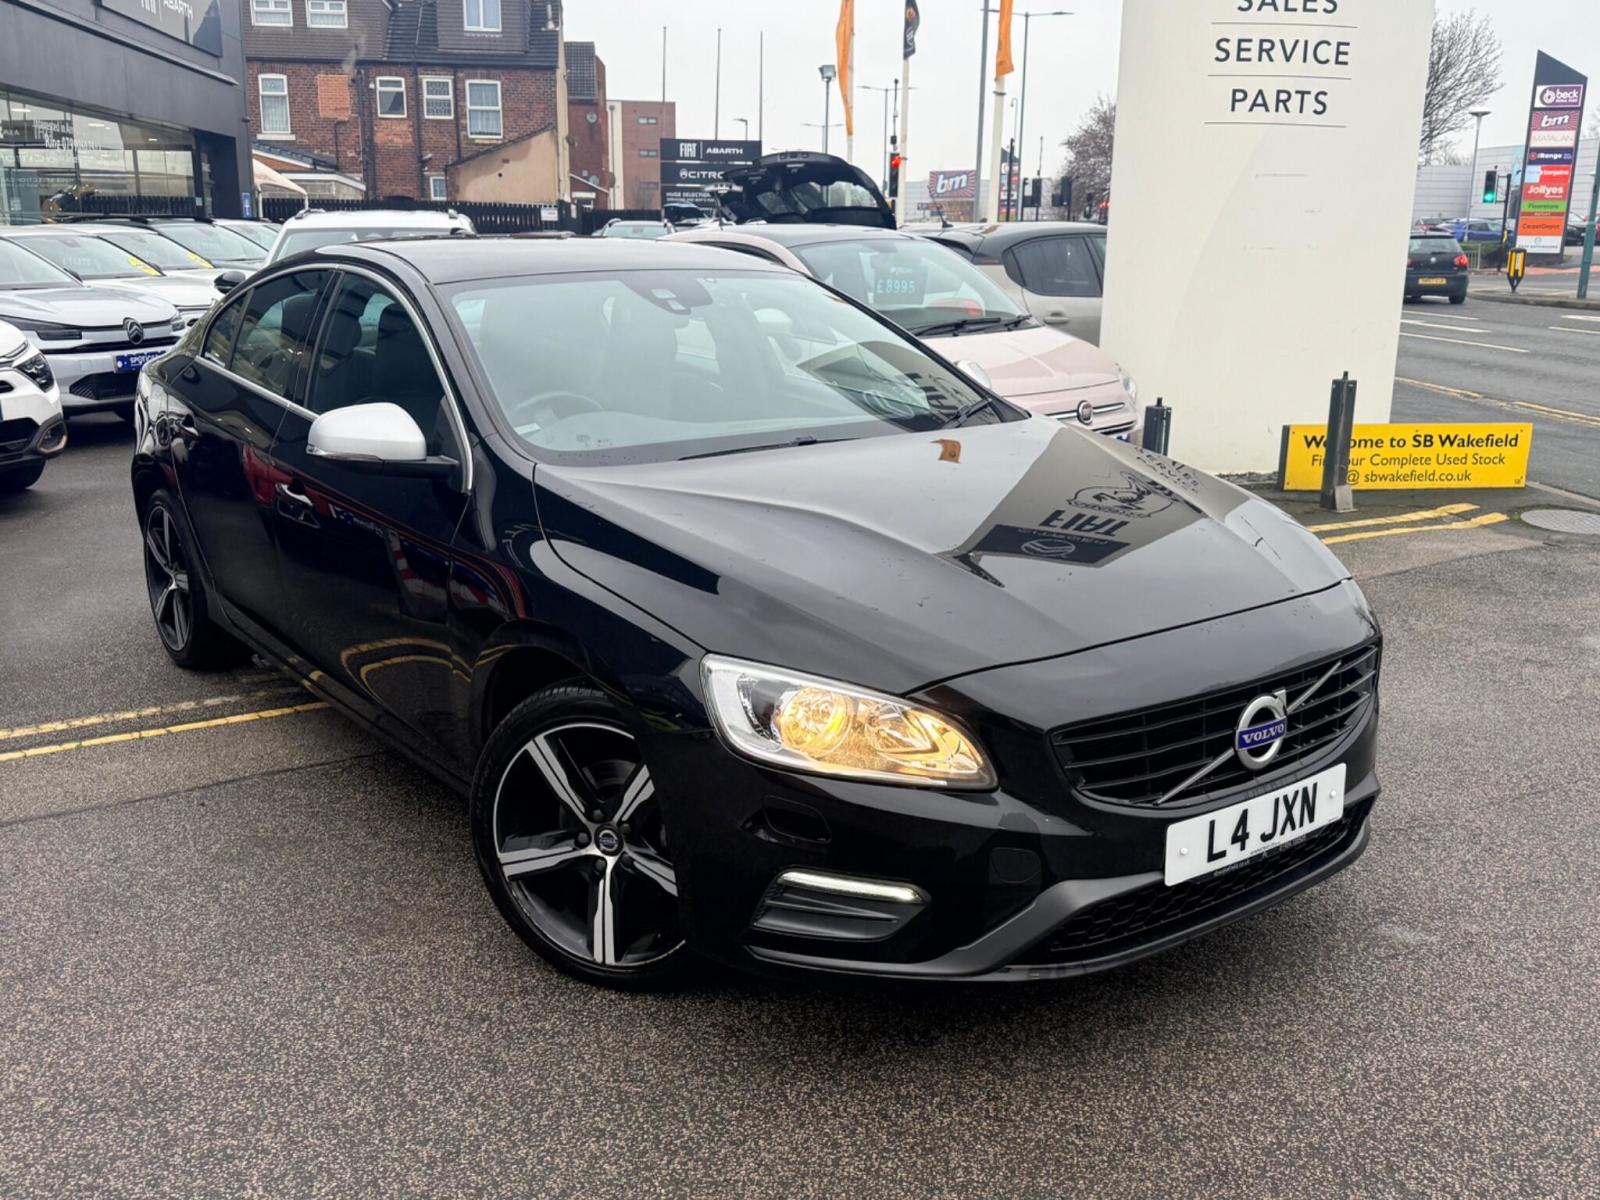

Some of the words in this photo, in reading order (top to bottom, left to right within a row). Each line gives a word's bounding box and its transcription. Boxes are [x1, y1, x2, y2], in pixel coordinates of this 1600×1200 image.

[1214, 37, 1350, 66] SERVICE
[1230, 88, 1328, 115] PARTS
[680, 142, 697, 158] FIAT
[876, 279, 916, 294] £8995
[1304, 434, 1384, 448] Wome
[1389, 437, 1406, 448] to
[1412, 434, 1434, 448] SB
[1438, 434, 1519, 448] Wakefield
[1370, 453, 1432, 469] Complete
[1436, 453, 1468, 465] Used
[1472, 452, 1505, 465] Stock
[1364, 469, 1472, 482] sbwakefield.co.uk
[1243, 723, 1286, 744] VOLVO
[1206, 808, 1250, 863] L4
[1260, 782, 1318, 843] JXN
